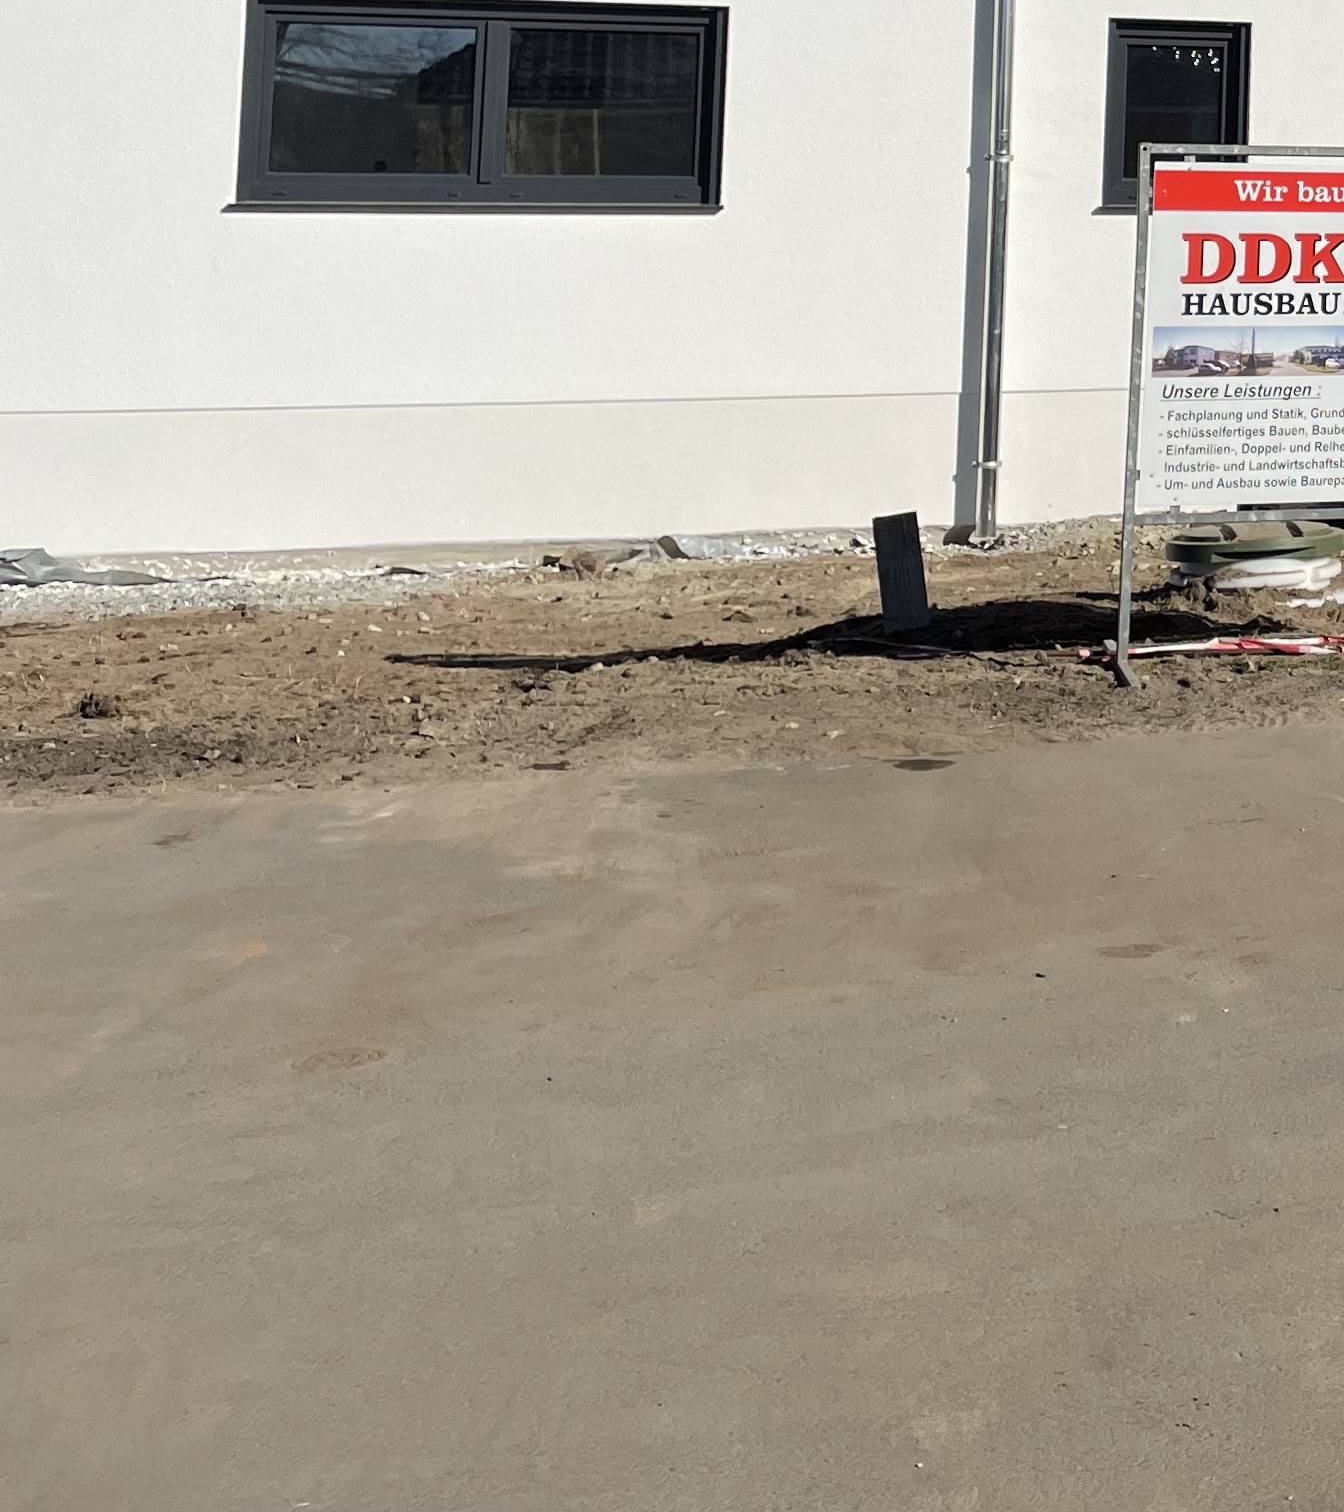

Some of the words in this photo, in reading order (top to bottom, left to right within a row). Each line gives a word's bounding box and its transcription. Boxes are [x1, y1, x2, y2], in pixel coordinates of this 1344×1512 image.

[1234, 179, 1288, 202] Wir
[1181, 292, 1342, 316] HAUSBAU
[1162, 384, 1219, 399] Unsere
[1223, 383, 1312, 400] Leistungen
[1167, 409, 1243, 423] Fachplanung
[1246, 408, 1268, 420] und
[1271, 407, 1307, 420] Statik,
[1166, 426, 1265, 439] schlüsselfertiges
[1269, 425, 1308, 437] Bauen,
[1166, 444, 1238, 456] Einfamilien-,
[1241, 442, 1286, 456] Doppel-
[1289, 442, 1311, 453] und
[1164, 461, 1221, 473] Industrie-
[1223, 460, 1245, 472] und
[1164, 479, 1188, 490] Um-
[1191, 478, 1213, 489] und
[1216, 476, 1260, 489] Ausbau
[1264, 476, 1297, 488] sowie
